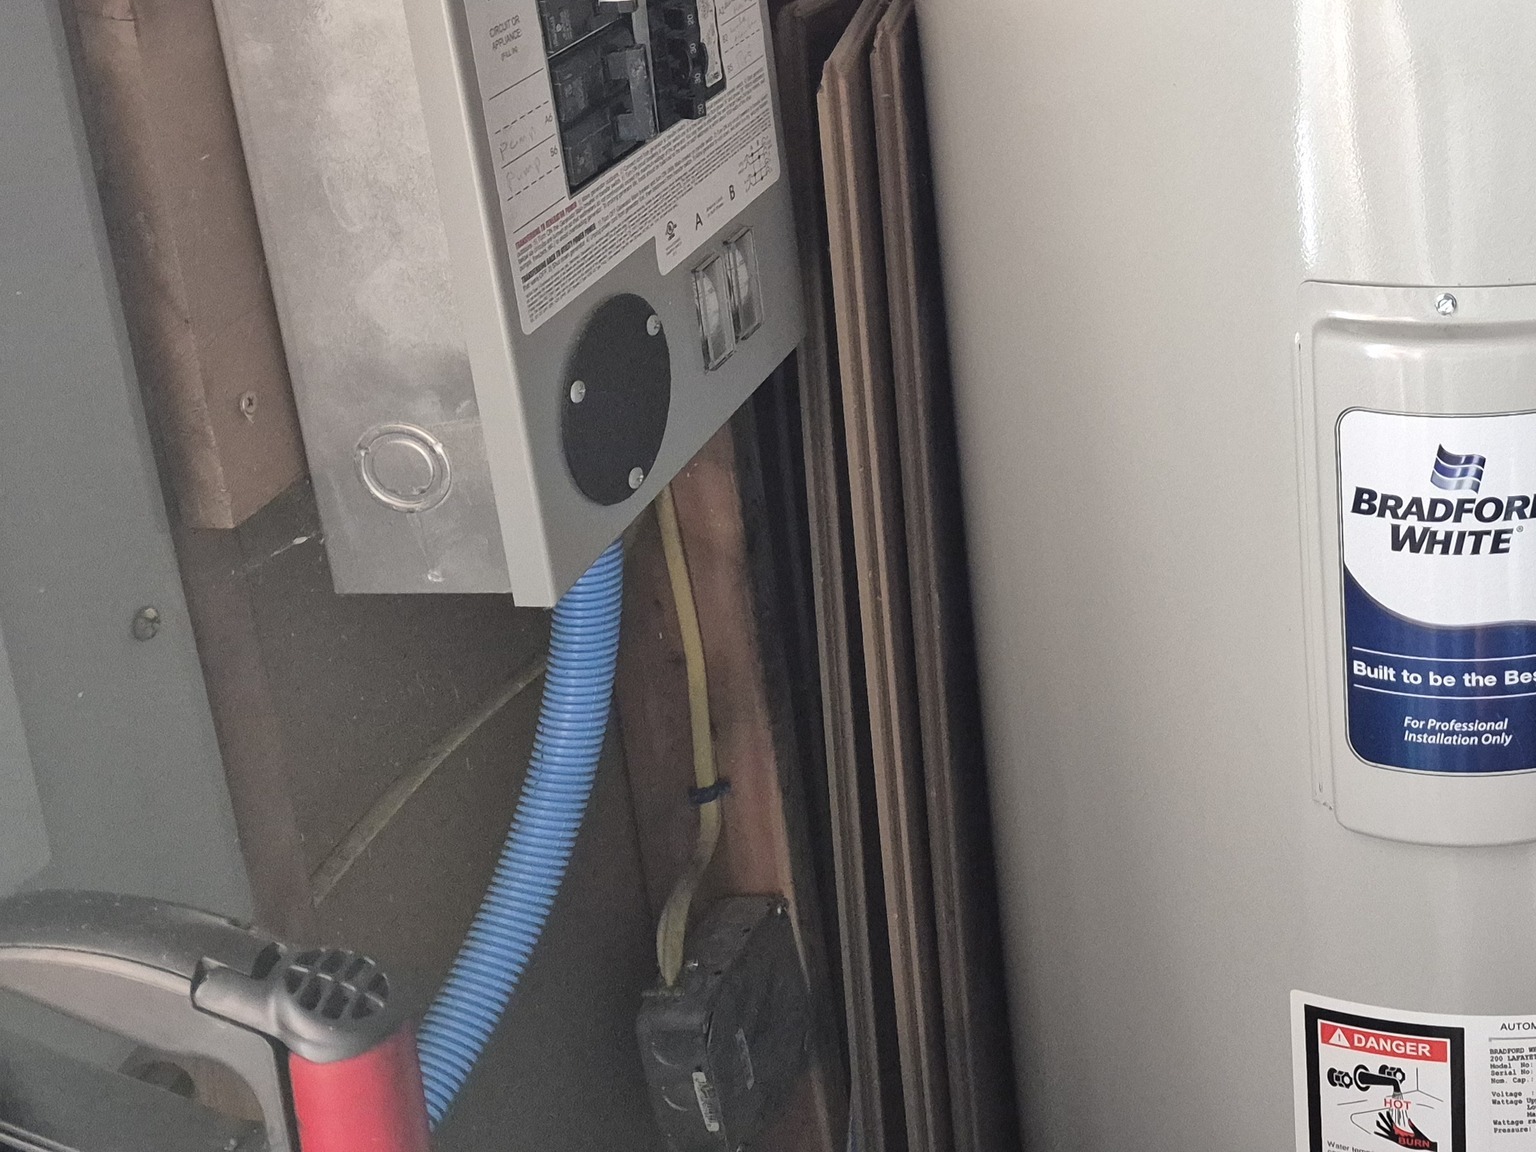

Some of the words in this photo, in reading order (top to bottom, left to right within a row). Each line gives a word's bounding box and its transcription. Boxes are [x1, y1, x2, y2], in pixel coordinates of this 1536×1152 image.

[686, 14, 695, 26] 20
[489, 18, 512, 39] CIRCUIT
[689, 42, 697, 55] 30
[695, 212, 704, 231] A
[728, 184, 736, 201] B
[1389, 523, 1515, 556] WHITE
[1353, 660, 1396, 682] Built
[1401, 666, 1422, 686] to
[1429, 667, 1456, 687] be
[1463, 667, 1497, 687] the
[1403, 716, 1426, 730] For
[1427, 717, 1509, 732] Professional
[1403, 730, 1479, 746] Installation
[1481, 731, 1513, 747] Only
[1353, 1033, 1431, 1057] DANGER
[1490, 1069, 1517, 1077] Serial
[1383, 1098, 1412, 1111] HOT
[1492, 1098, 1523, 1106] Wattage
[1327, 1140, 1350, 1151] Water
[1398, 1136, 1431, 1148] BURN
